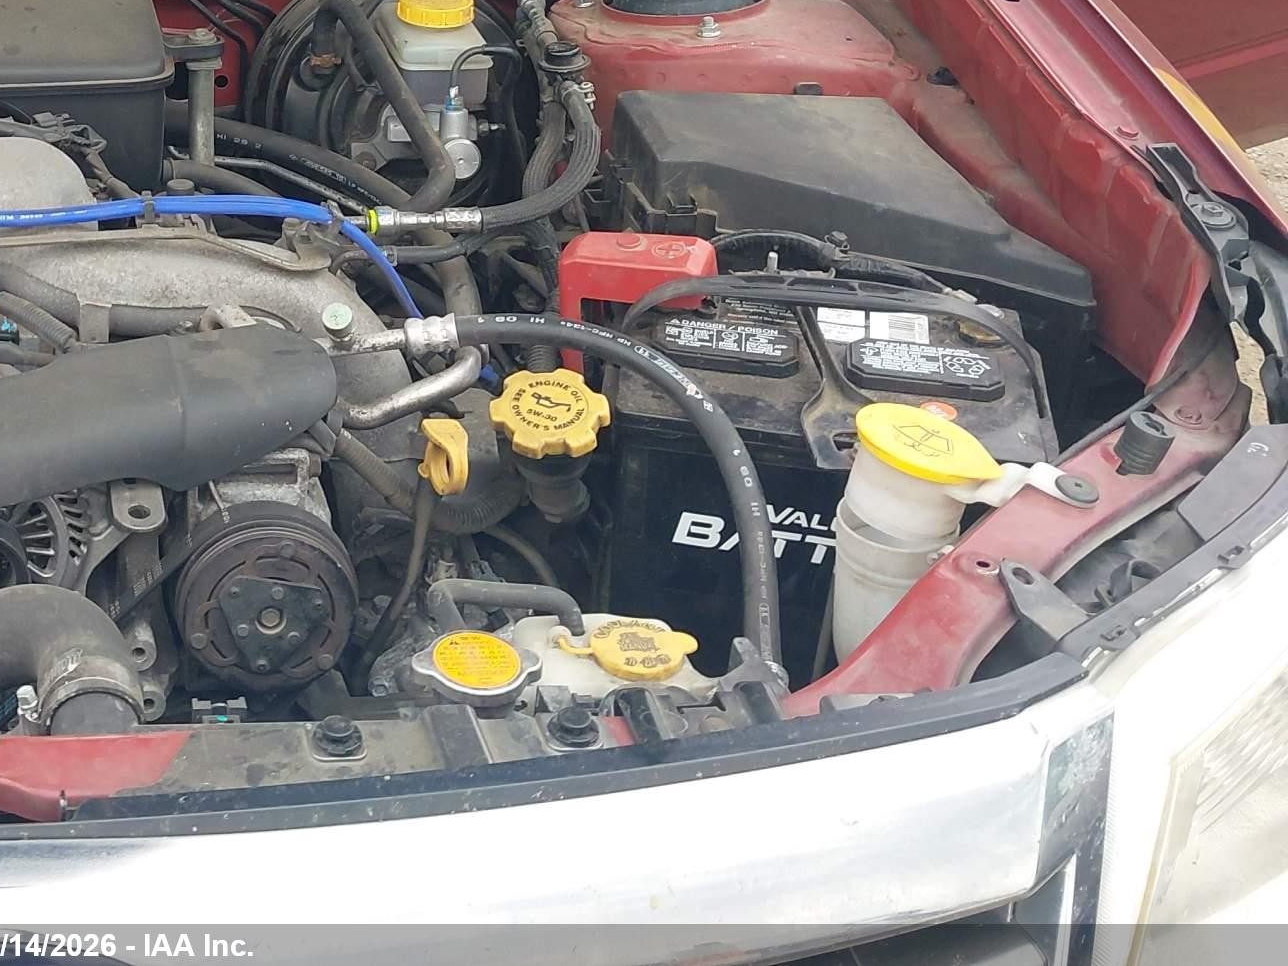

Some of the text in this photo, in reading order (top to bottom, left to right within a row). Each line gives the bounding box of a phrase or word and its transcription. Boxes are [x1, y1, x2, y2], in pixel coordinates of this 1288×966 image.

[681, 319, 726, 331] DANGER
[737, 326, 779, 336] POISON
[528, 380, 583, 403] ENGINE OIL
[512, 387, 585, 432] SEE OWNER'S MANUAL
[526, 408, 558, 423] 5W-30
[671, 511, 837, 565] BTT
